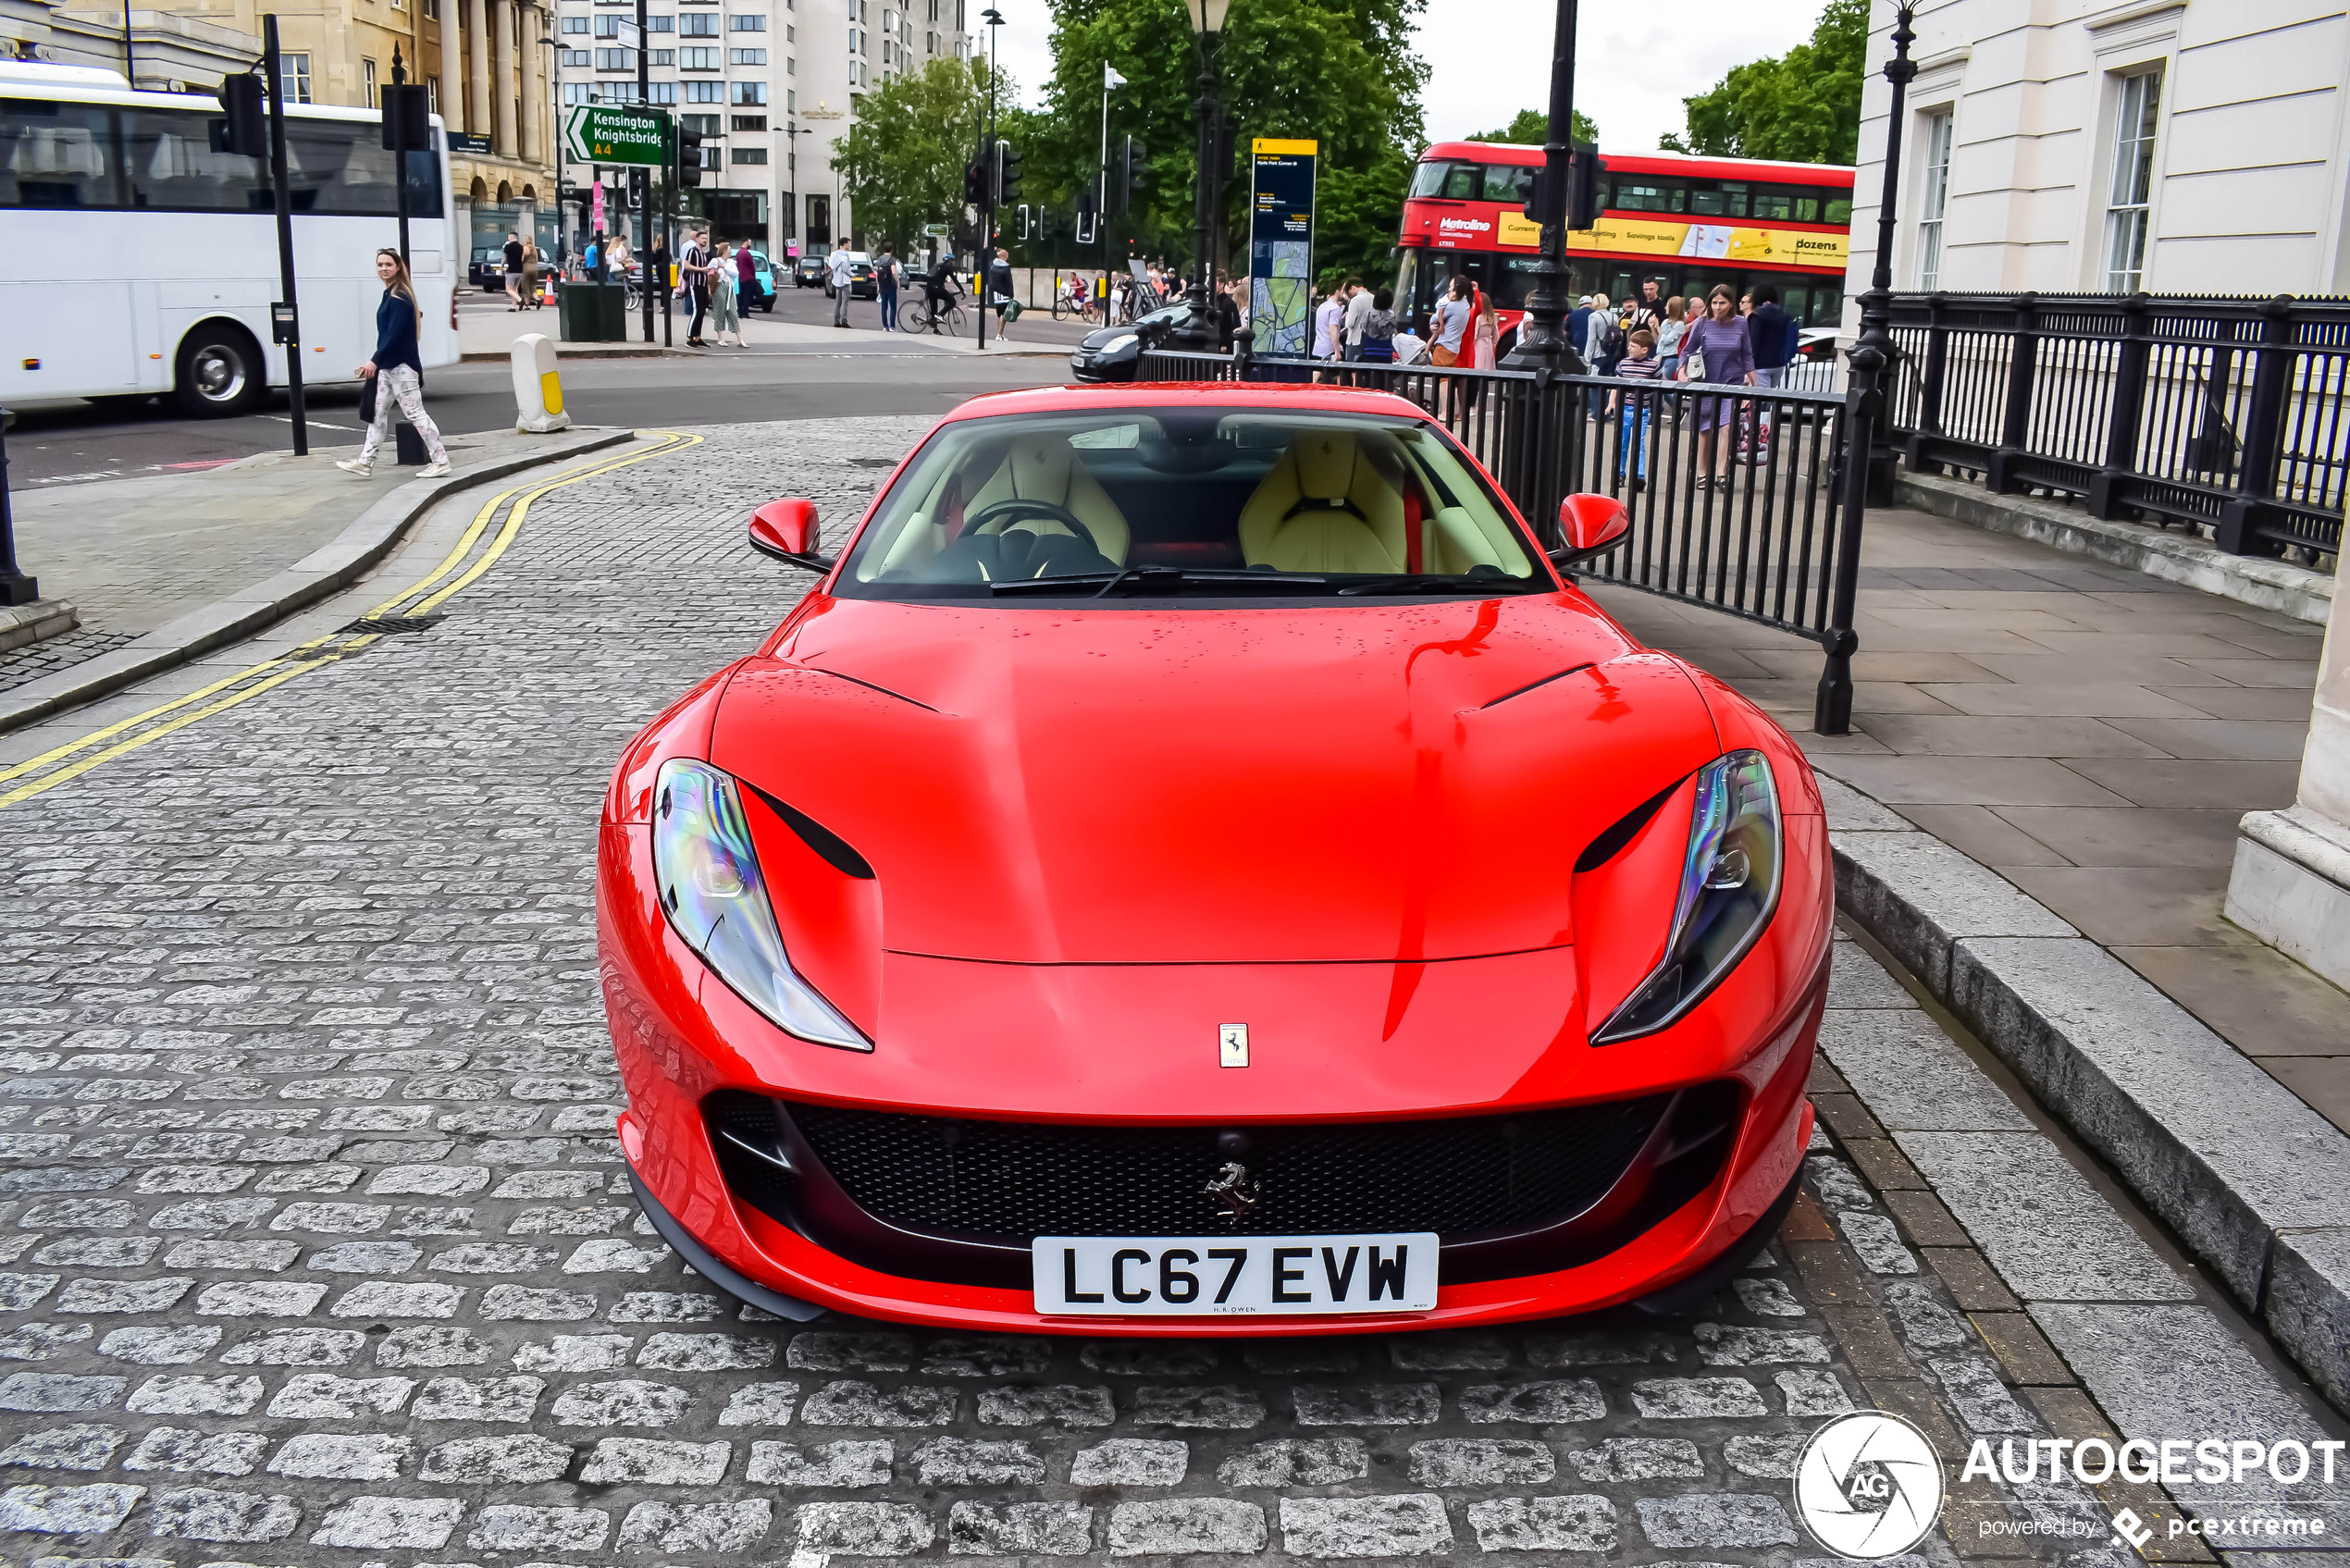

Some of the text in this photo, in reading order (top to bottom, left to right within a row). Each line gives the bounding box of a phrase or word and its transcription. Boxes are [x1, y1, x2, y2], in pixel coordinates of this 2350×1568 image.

[594, 112, 655, 130] Kensington
[594, 128, 662, 147] Knightsbridg
[1440, 216, 1490, 231] Metroline
[1577, 229, 1616, 239] Budgeting
[1626, 232, 1655, 241] Savings
[1797, 239, 1837, 251] dozens
[1508, 260, 1516, 268] 16
[1064, 1244, 1408, 1304] LC67 EVW
